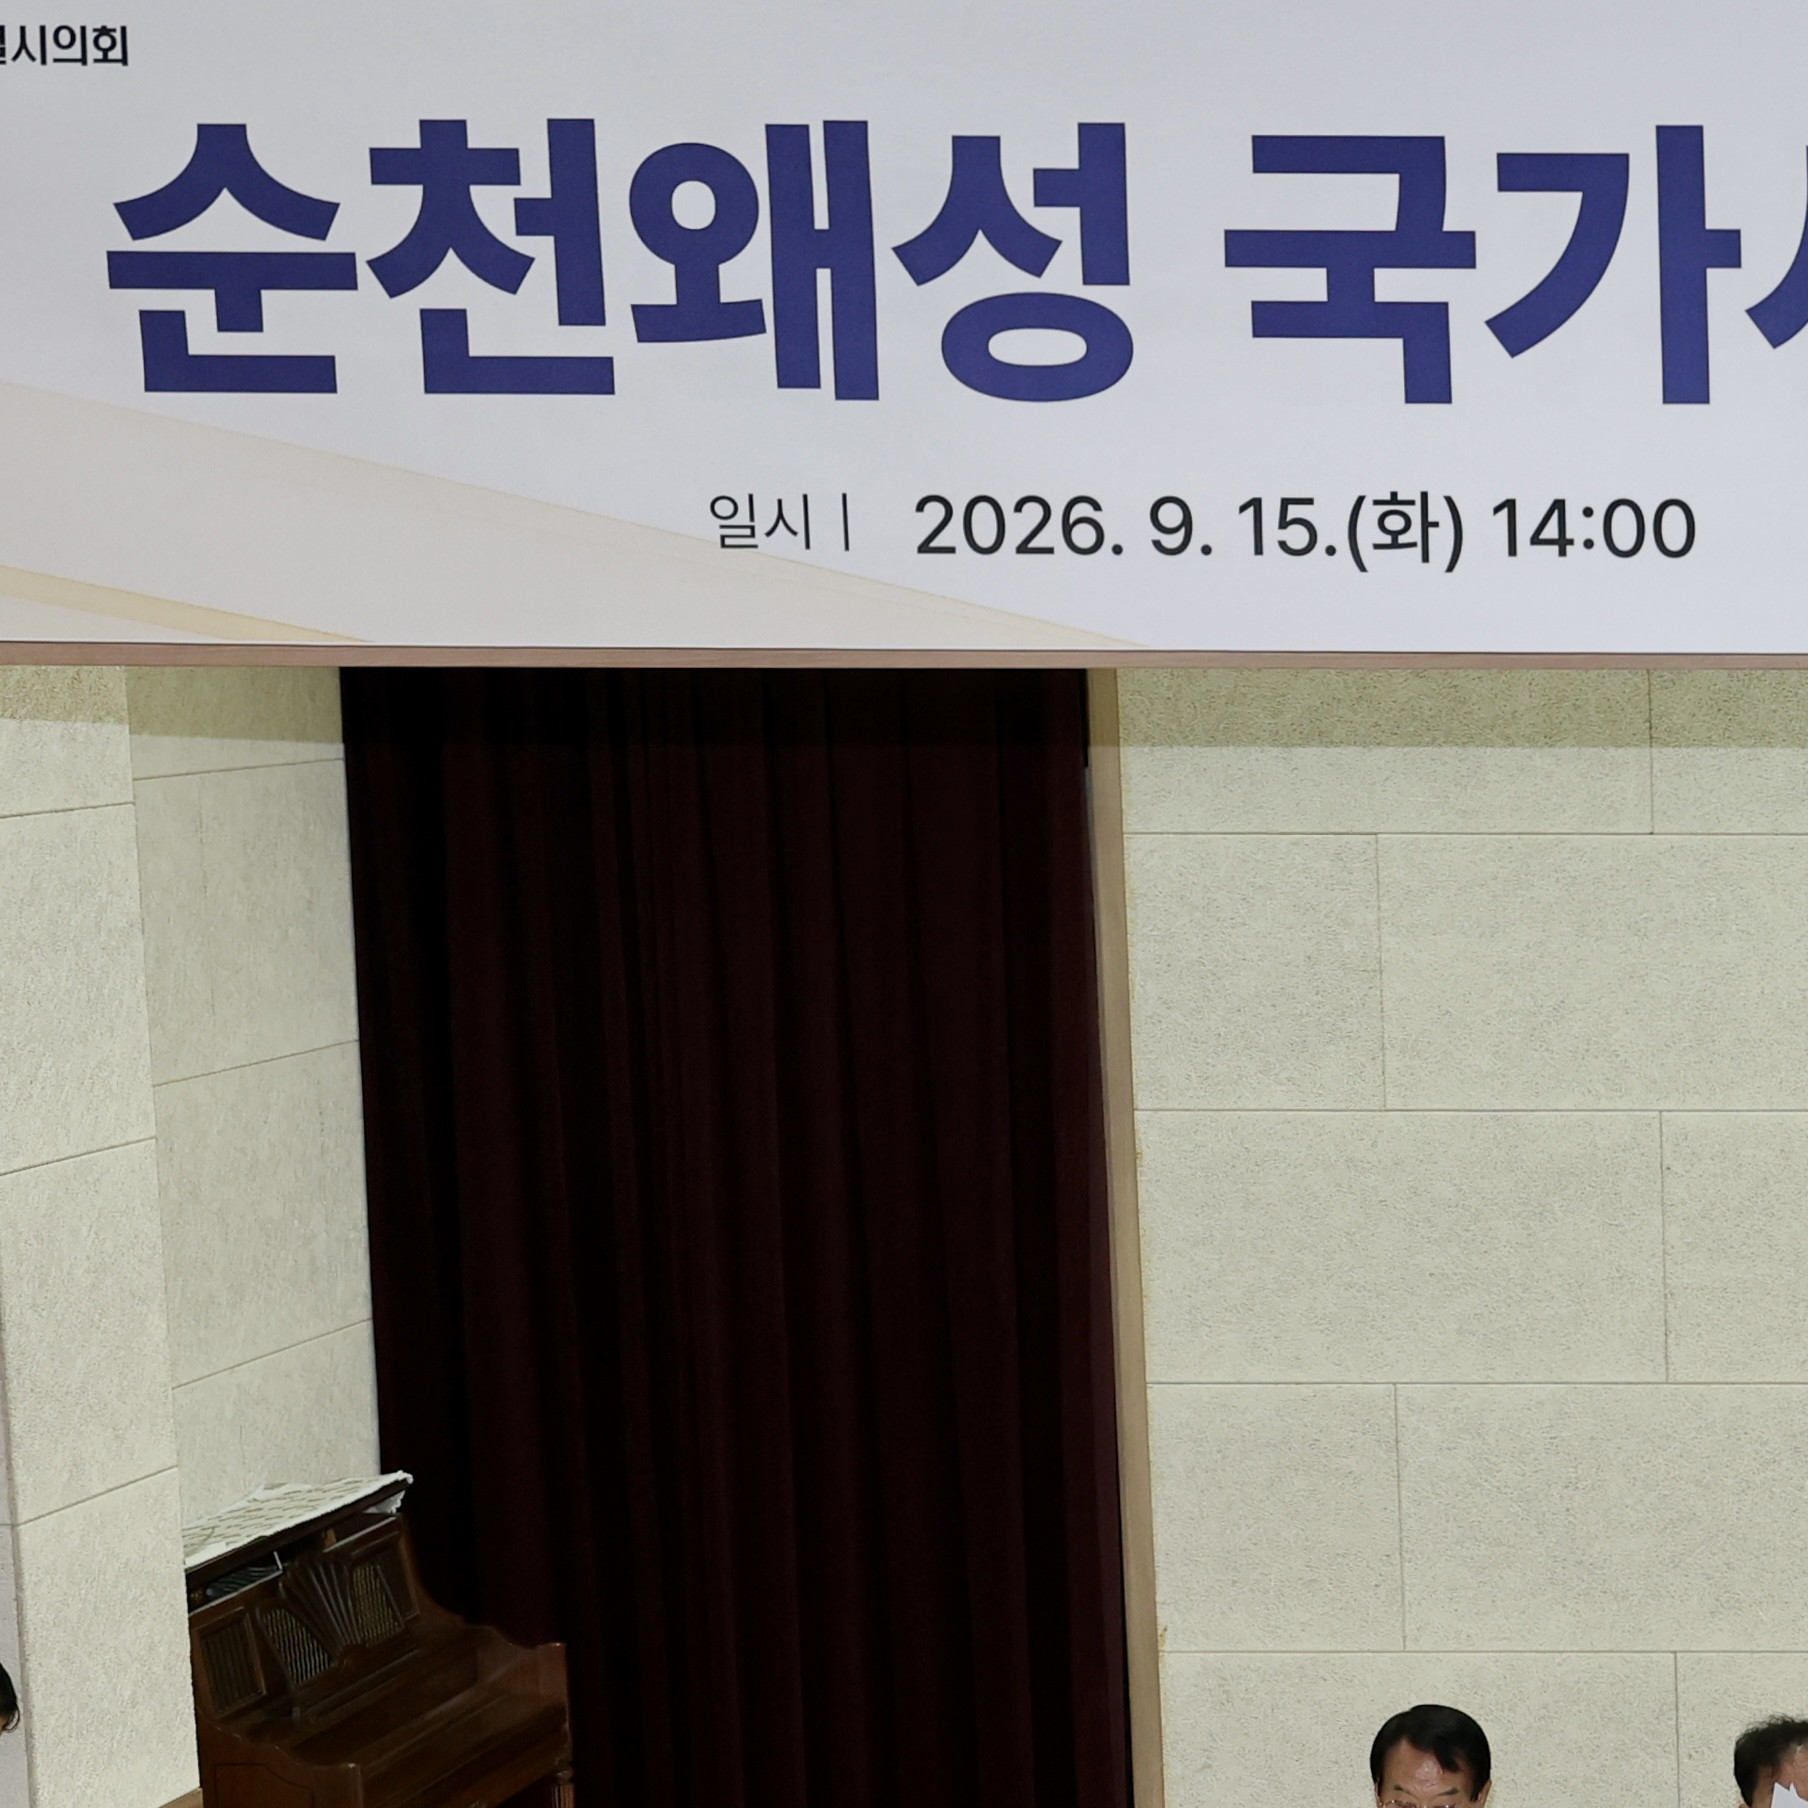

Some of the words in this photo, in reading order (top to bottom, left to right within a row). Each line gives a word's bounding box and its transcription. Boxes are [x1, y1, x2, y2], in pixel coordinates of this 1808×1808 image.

[106, 118, 1133, 402] 순천왜성
[710, 494, 810, 550] 일시
[915, 495, 1123, 555] 2026.
[1150, 496, 1212, 556] 9.
[1239, 491, 1463, 573] 15.(화)
[1493, 498, 1695, 558] 14:00
